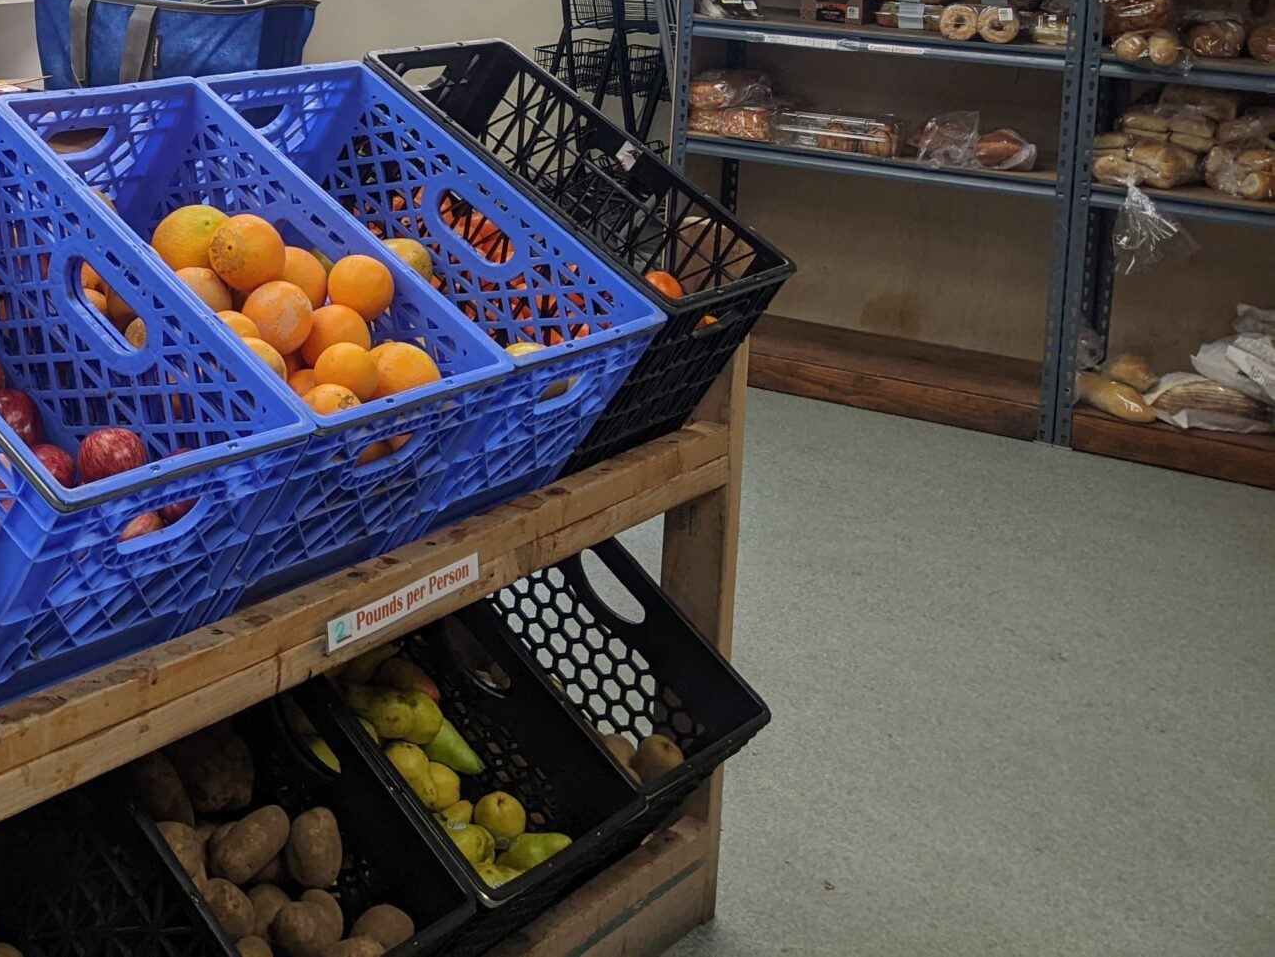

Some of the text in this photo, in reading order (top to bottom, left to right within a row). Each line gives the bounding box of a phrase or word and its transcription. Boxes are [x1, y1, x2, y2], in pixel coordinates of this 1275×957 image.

[335, 563, 470, 641] 2 Pounds per Person
